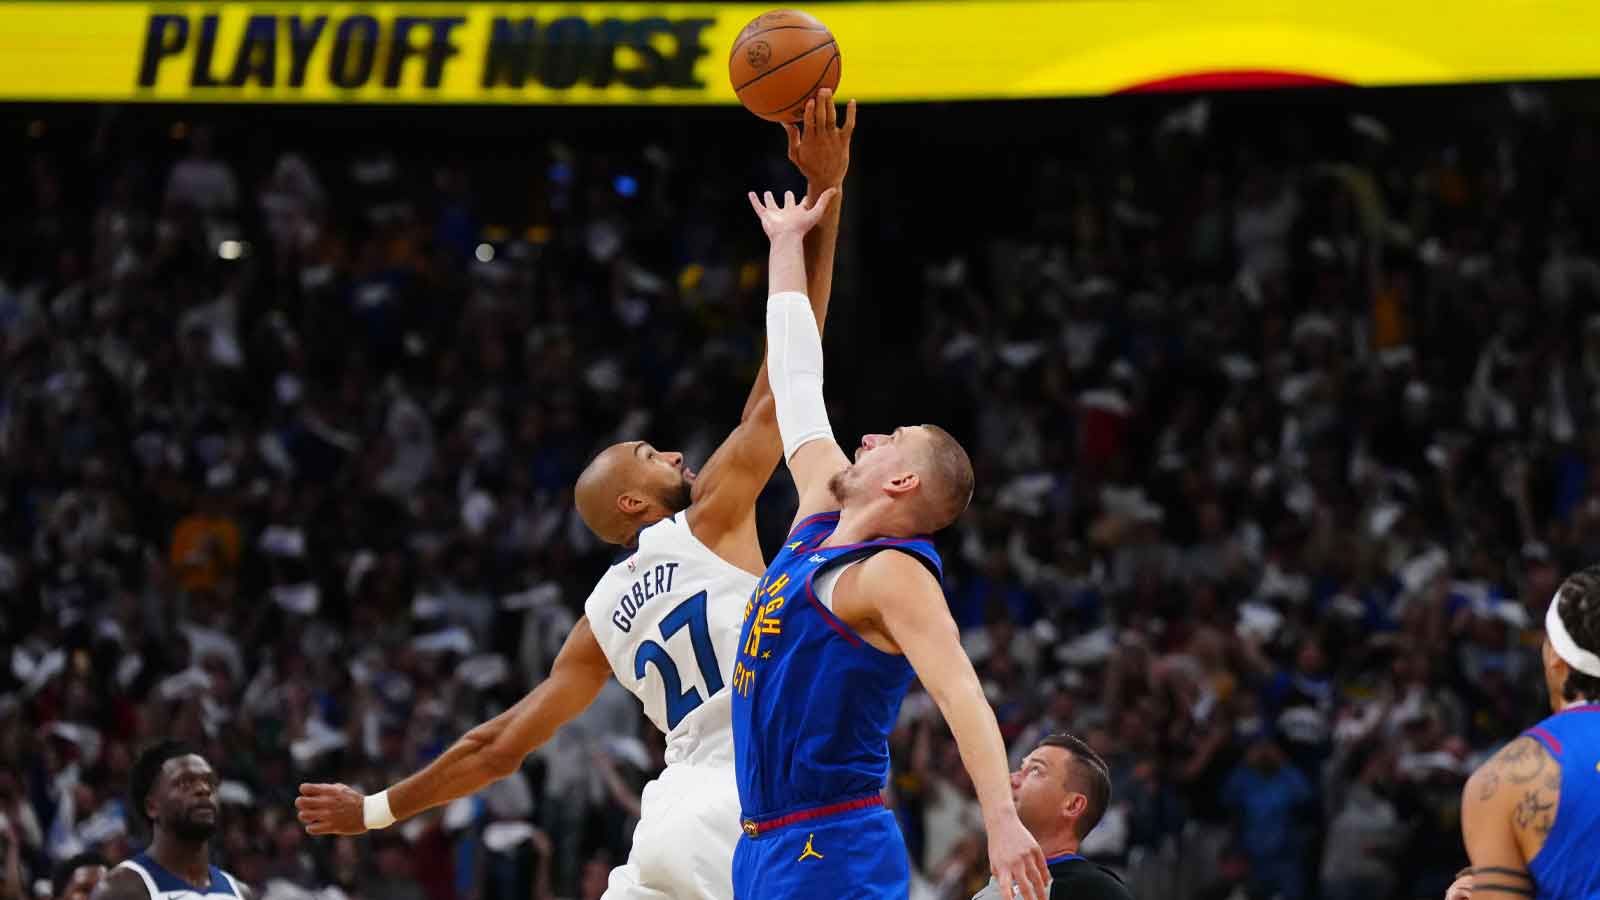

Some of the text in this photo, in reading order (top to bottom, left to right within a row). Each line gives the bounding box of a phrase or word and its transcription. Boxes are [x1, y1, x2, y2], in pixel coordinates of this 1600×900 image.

[138, 14, 716, 89] PLAYOFF NOISE
[612, 562, 679, 633] GOBERT
[634, 589, 725, 732] 27
